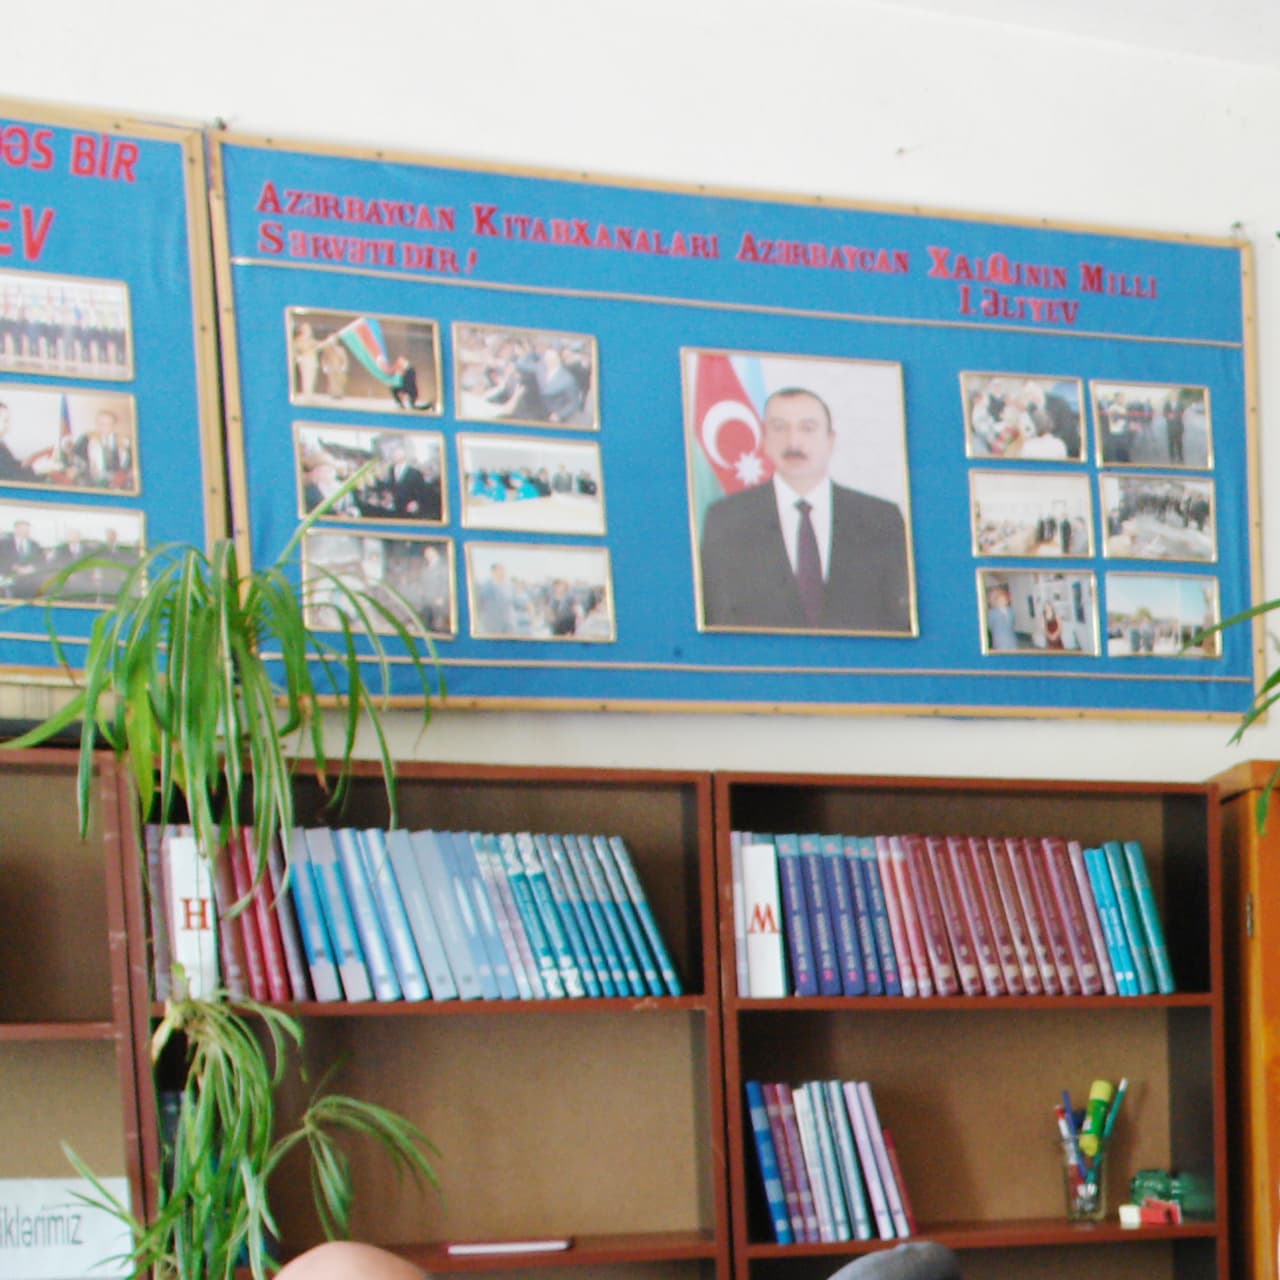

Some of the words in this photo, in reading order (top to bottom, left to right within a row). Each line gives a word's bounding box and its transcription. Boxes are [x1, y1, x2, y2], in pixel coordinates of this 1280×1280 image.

[0, 125, 54, 172] ƏS
[181, 898, 210, 931] H
[747, 903, 779, 934] M
